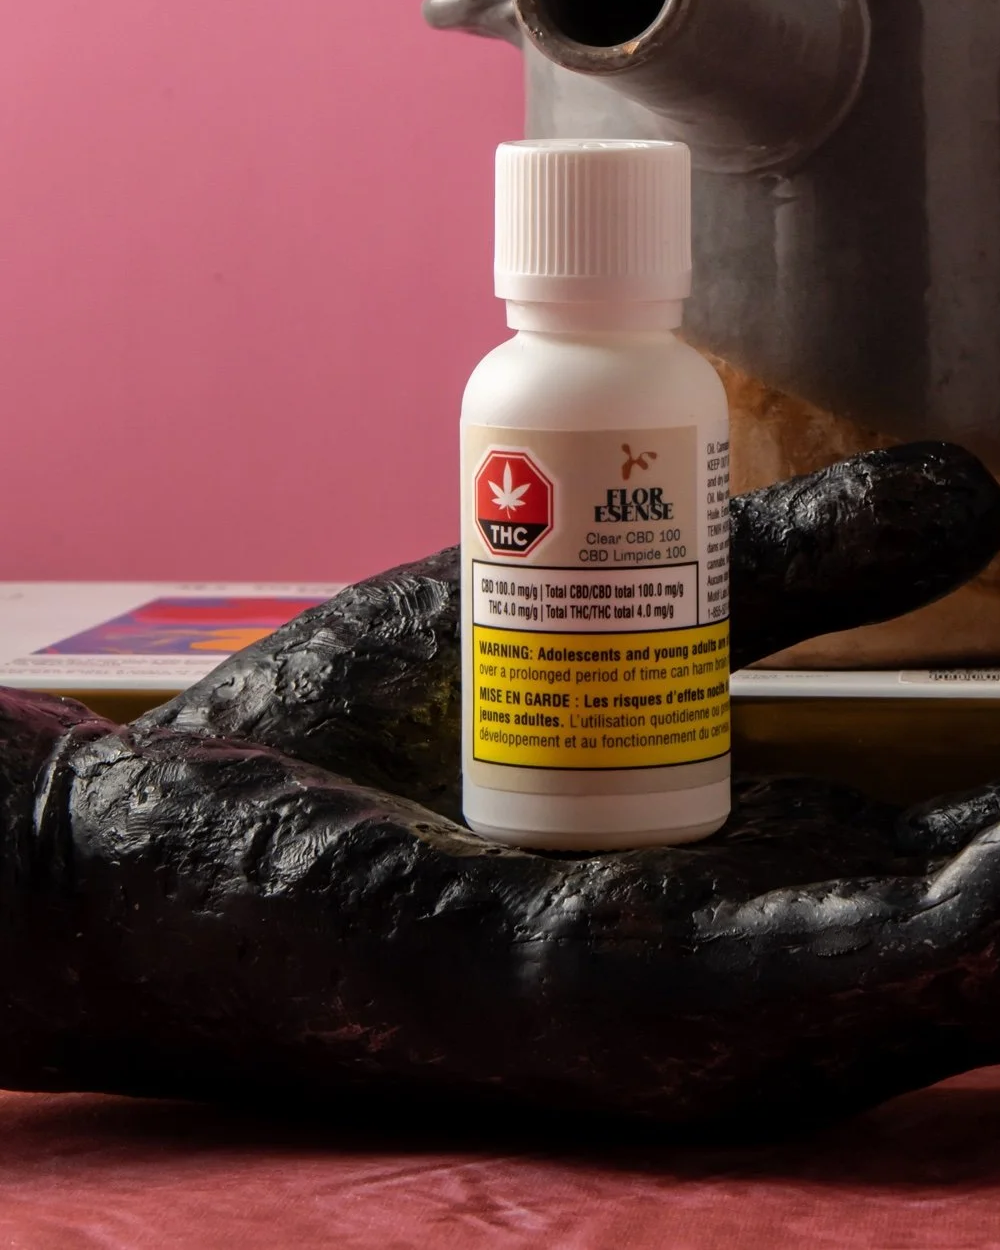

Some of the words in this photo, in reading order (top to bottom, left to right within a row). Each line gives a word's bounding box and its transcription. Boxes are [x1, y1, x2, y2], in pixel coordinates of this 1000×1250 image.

[707, 458, 720, 470] KEEP
[606, 487, 664, 507] FLOR
[594, 502, 674, 523] ESENSE
[491, 525, 528, 546] THC
[586, 532, 621, 545] Clear
[626, 531, 654, 544] CBD
[660, 529, 681, 541] 100
[579, 549, 608, 562] CBD
[613, 547, 661, 564] Limpide
[666, 545, 686, 559] 100
[481, 578, 494, 594] CBD
[495, 580, 515, 596] 100.0
[517, 583, 538, 600] mg/g
[546, 583, 567, 598] Total
[569, 583, 612, 601] CBD/CBD
[614, 582, 635, 598] total
[638, 583, 662, 597] 100.0
[664, 581, 684, 599] mg/g
[489, 600, 502, 615] THC
[503, 602, 516, 616] 4.0
[517, 604, 538, 620] mg/g
[546, 604, 567, 619] Total
[570, 604, 611, 621] THC/THC
[614, 603, 635, 618] total
[637, 604, 651, 617] 4.0
[653, 601, 674, 618] mg/g
[479, 640, 533, 660] WARNING:
[537, 647, 621, 662] Adolescents
[626, 646, 650, 661] and
[654, 645, 689, 663] young
[692, 639, 717, 655] adults
[479, 664, 497, 677] over
[500, 667, 507, 678] a
[509, 667, 571, 685] prolonged
[576, 669, 618, 685] period
[623, 667, 636, 682] of
[640, 666, 667, 681] time
[670, 665, 690, 679] can
[692, 661, 714, 676] harm
[479, 686, 503, 704] MISE
[505, 690, 521, 705] EN
[525, 691, 570, 708] GARDE
[584, 694, 609, 708] Les
[613, 693, 662, 710] risques
[666, 688, 705, 704] d'effets
[479, 706, 511, 724] jeunes
[514, 712, 565, 728] adultes.
[570, 712, 646, 729] L'utilisation
[650, 707, 710, 728] quotidienne
[711, 704, 720, 717] ou
[479, 726, 561, 748] développement
[564, 734, 577, 749] et
[581, 735, 597, 749] au
[602, 727, 697, 749] fonctionnement
[699, 726, 710, 741] du
